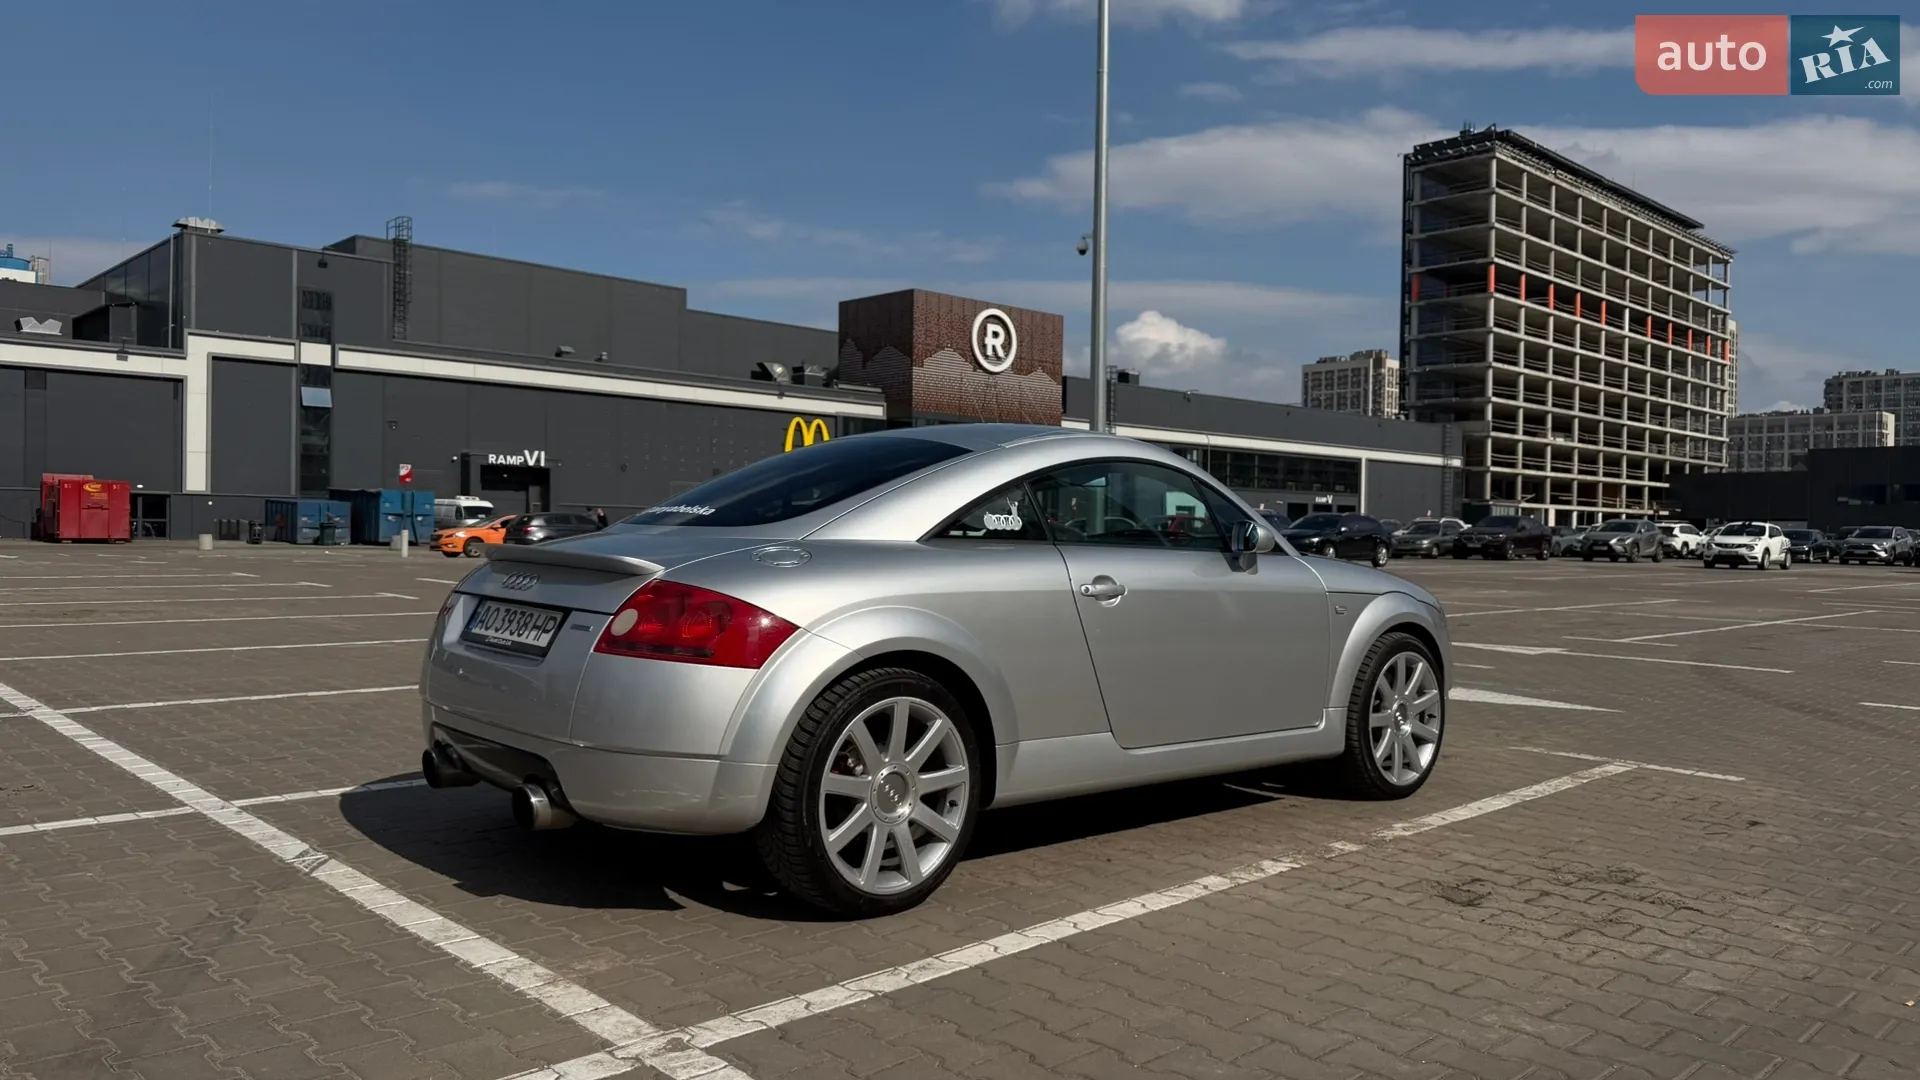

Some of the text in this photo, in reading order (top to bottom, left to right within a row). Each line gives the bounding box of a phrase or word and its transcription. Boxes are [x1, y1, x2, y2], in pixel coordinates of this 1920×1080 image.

[488, 449, 546, 467] RAMP VI
[494, 608, 534, 638] 3938
[525, 613, 558, 642] HP
